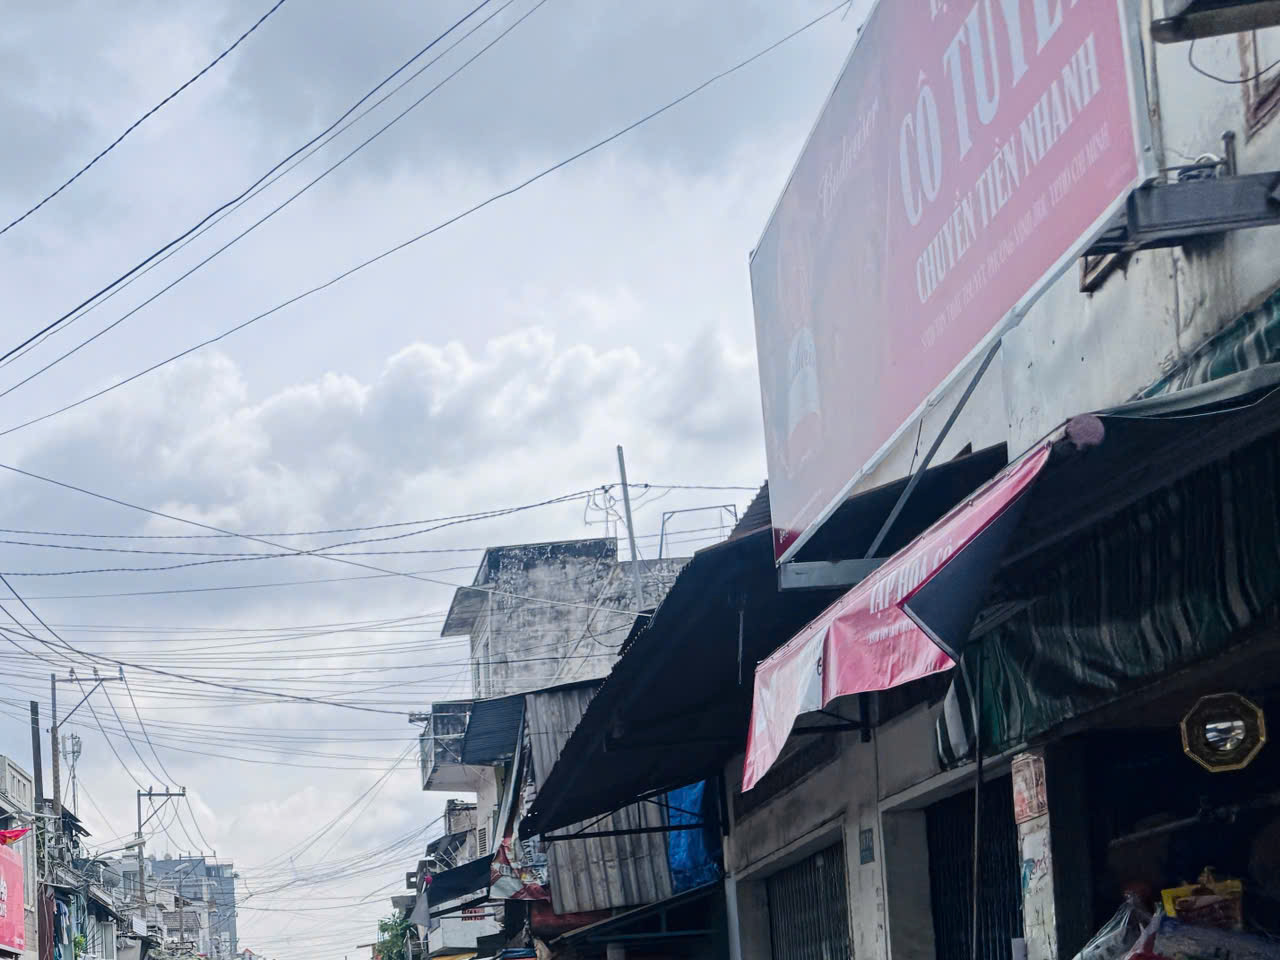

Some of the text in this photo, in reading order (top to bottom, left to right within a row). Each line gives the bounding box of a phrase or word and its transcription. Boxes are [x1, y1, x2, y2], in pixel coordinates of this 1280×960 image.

[899, 69, 942, 226] CÔ
[975, 136, 1020, 229] TIỀN
[1019, 31, 1101, 177] NHANH
